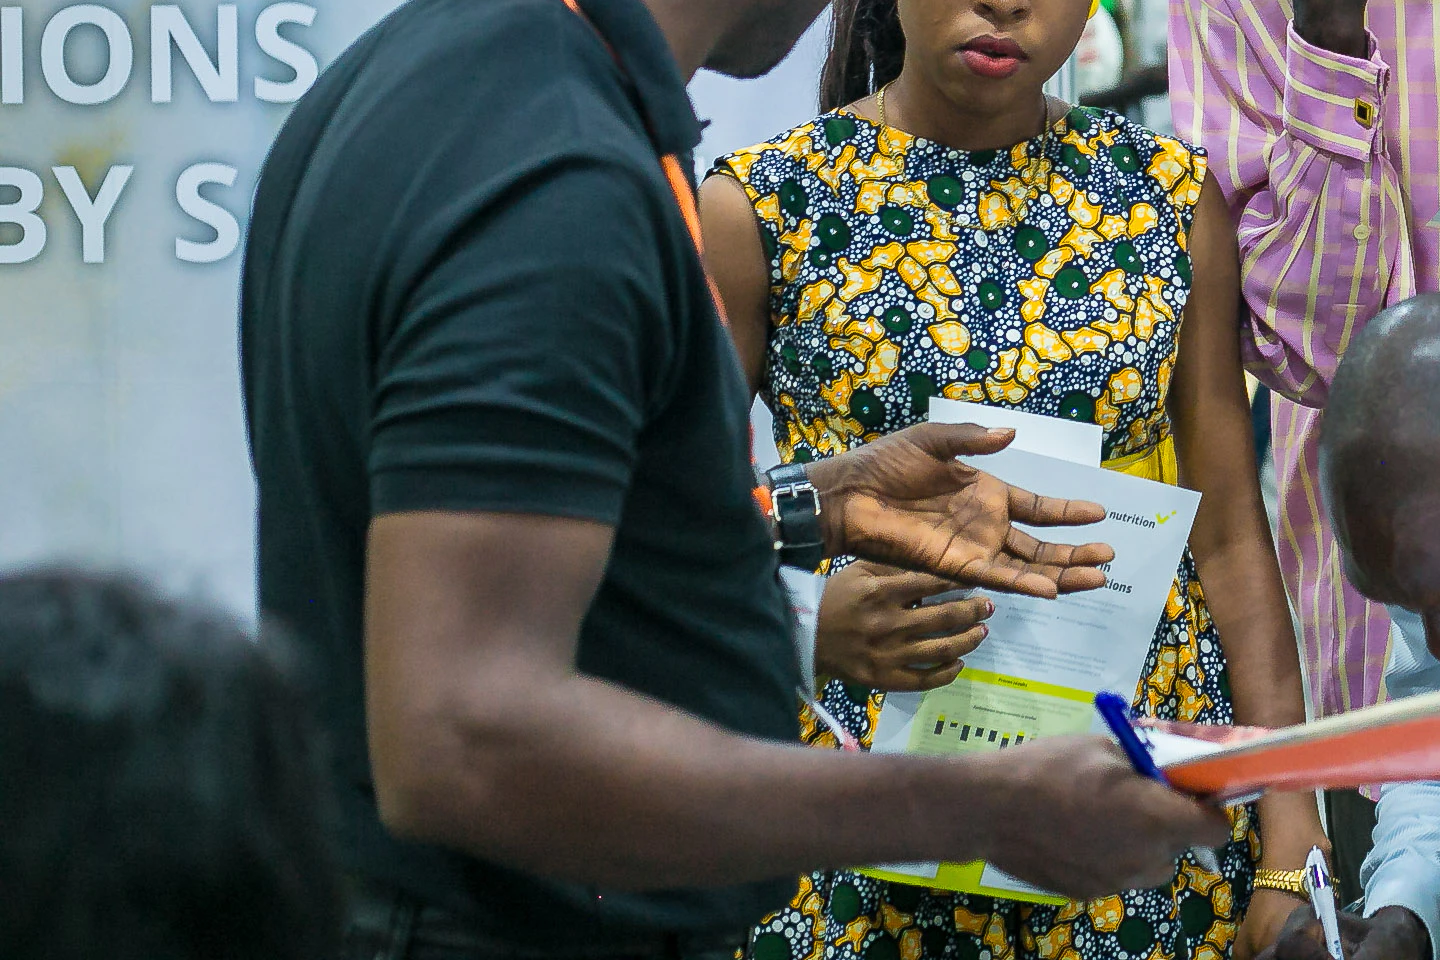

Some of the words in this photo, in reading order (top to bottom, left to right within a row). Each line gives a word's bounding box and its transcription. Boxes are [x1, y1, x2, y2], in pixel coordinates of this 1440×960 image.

[0, 164, 135, 266] BY
[174, 162, 242, 264] S
[1108, 510, 1156, 529] nutrition
